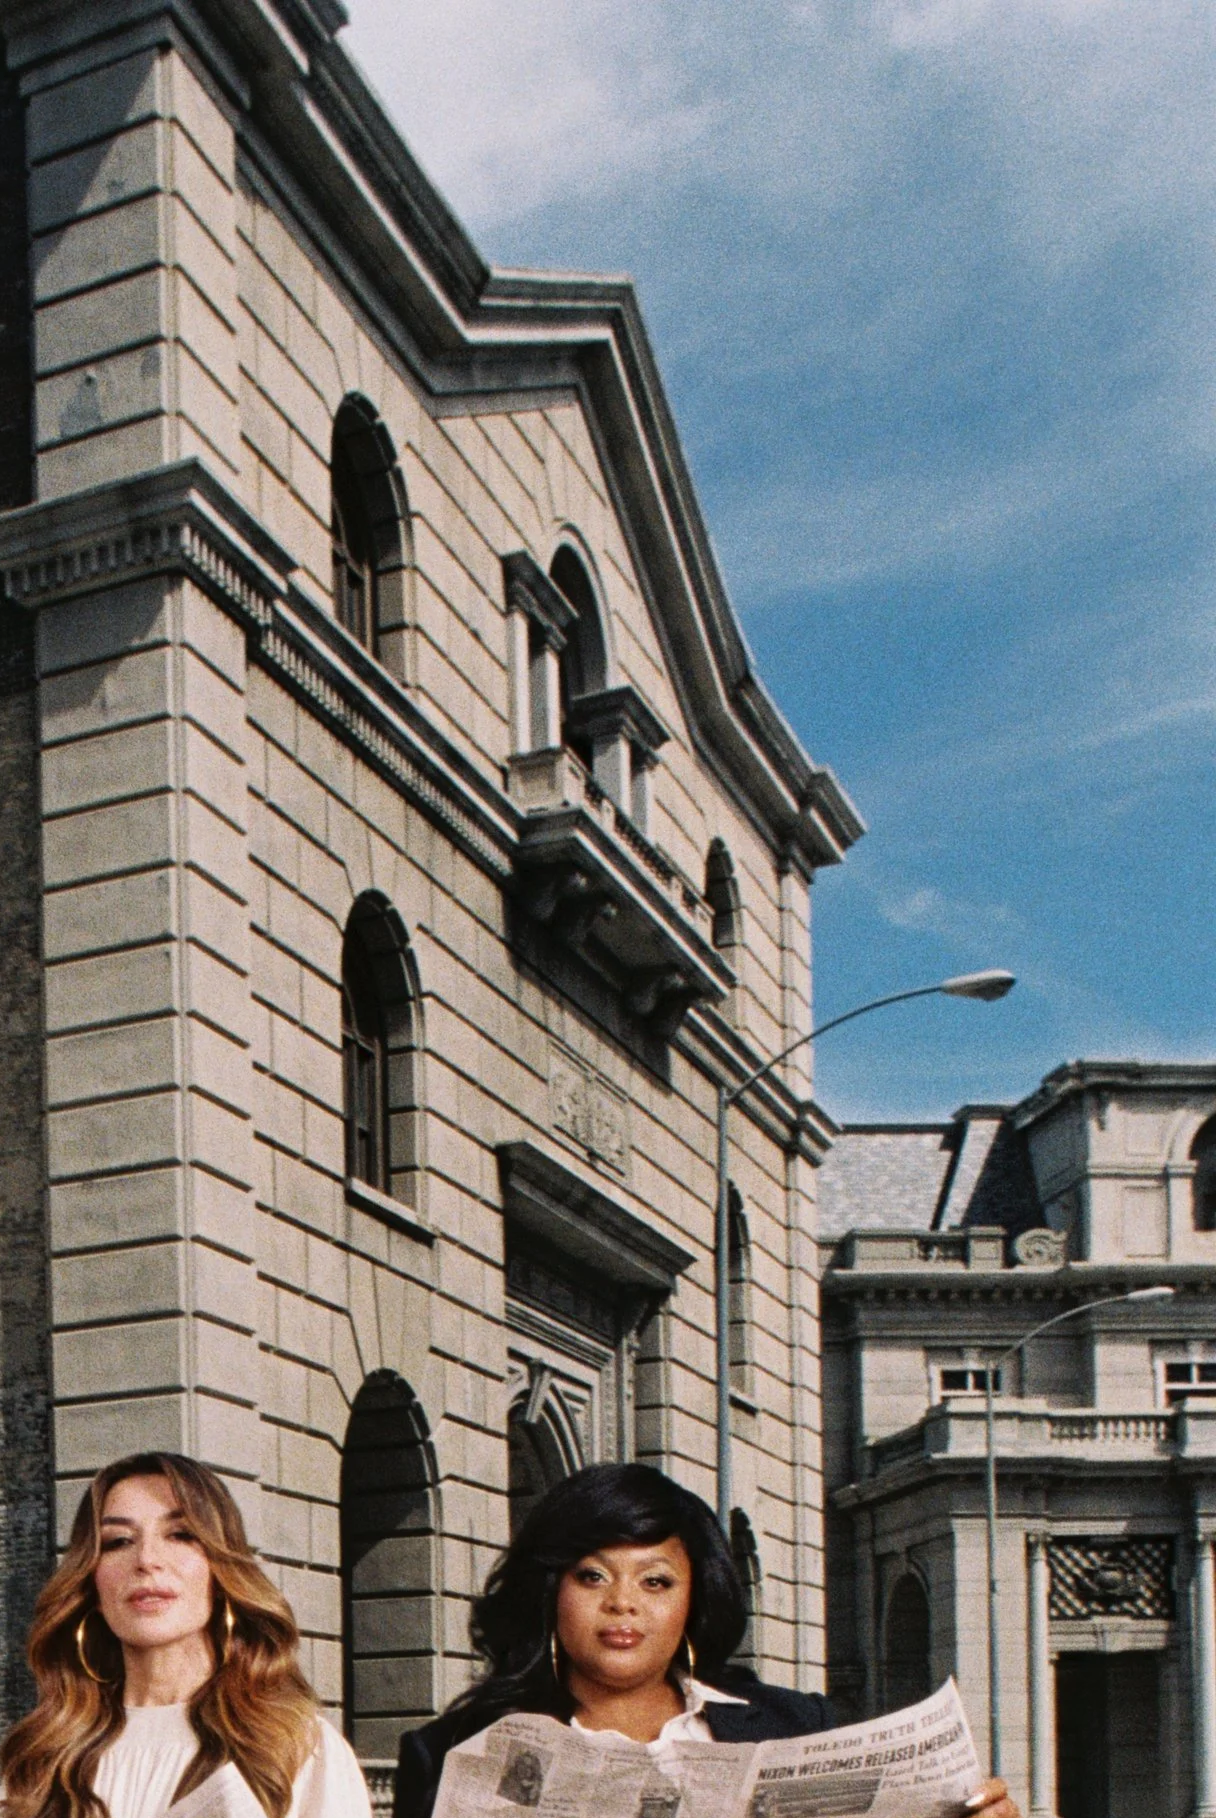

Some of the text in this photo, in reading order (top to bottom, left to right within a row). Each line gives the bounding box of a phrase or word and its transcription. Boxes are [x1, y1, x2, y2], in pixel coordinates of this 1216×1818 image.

[803, 1735, 863, 1755] TOLEDO
[758, 1764, 795, 1781] NIXON
[798, 1755, 862, 1776] WELCOMES
[864, 1744, 917, 1768] RELEASED
